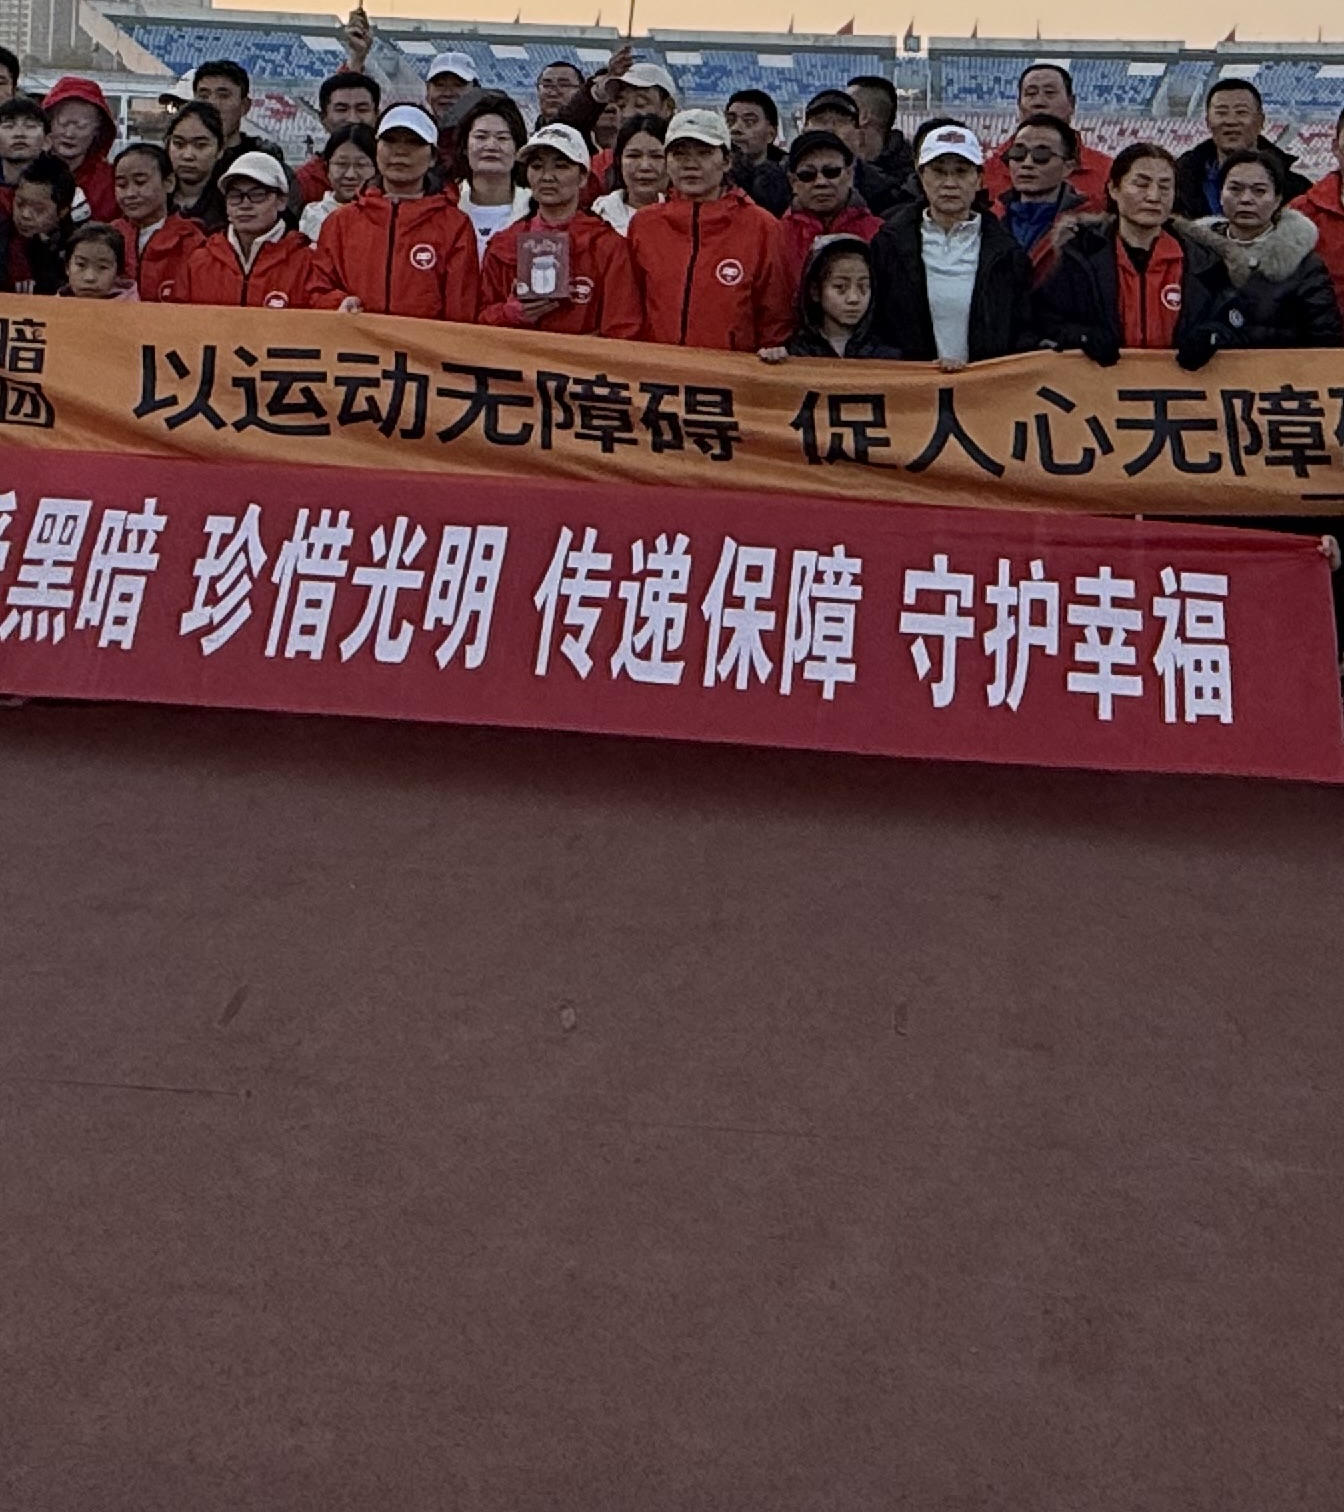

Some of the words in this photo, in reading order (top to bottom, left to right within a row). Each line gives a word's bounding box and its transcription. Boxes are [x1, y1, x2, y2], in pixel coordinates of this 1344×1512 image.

[134, 344, 741, 462] 以运动无障碍
[179, 502, 509, 670] 珍惜光明
[533, 525, 863, 700] 传递保障
[899, 554, 1233, 724] 守护幸福
